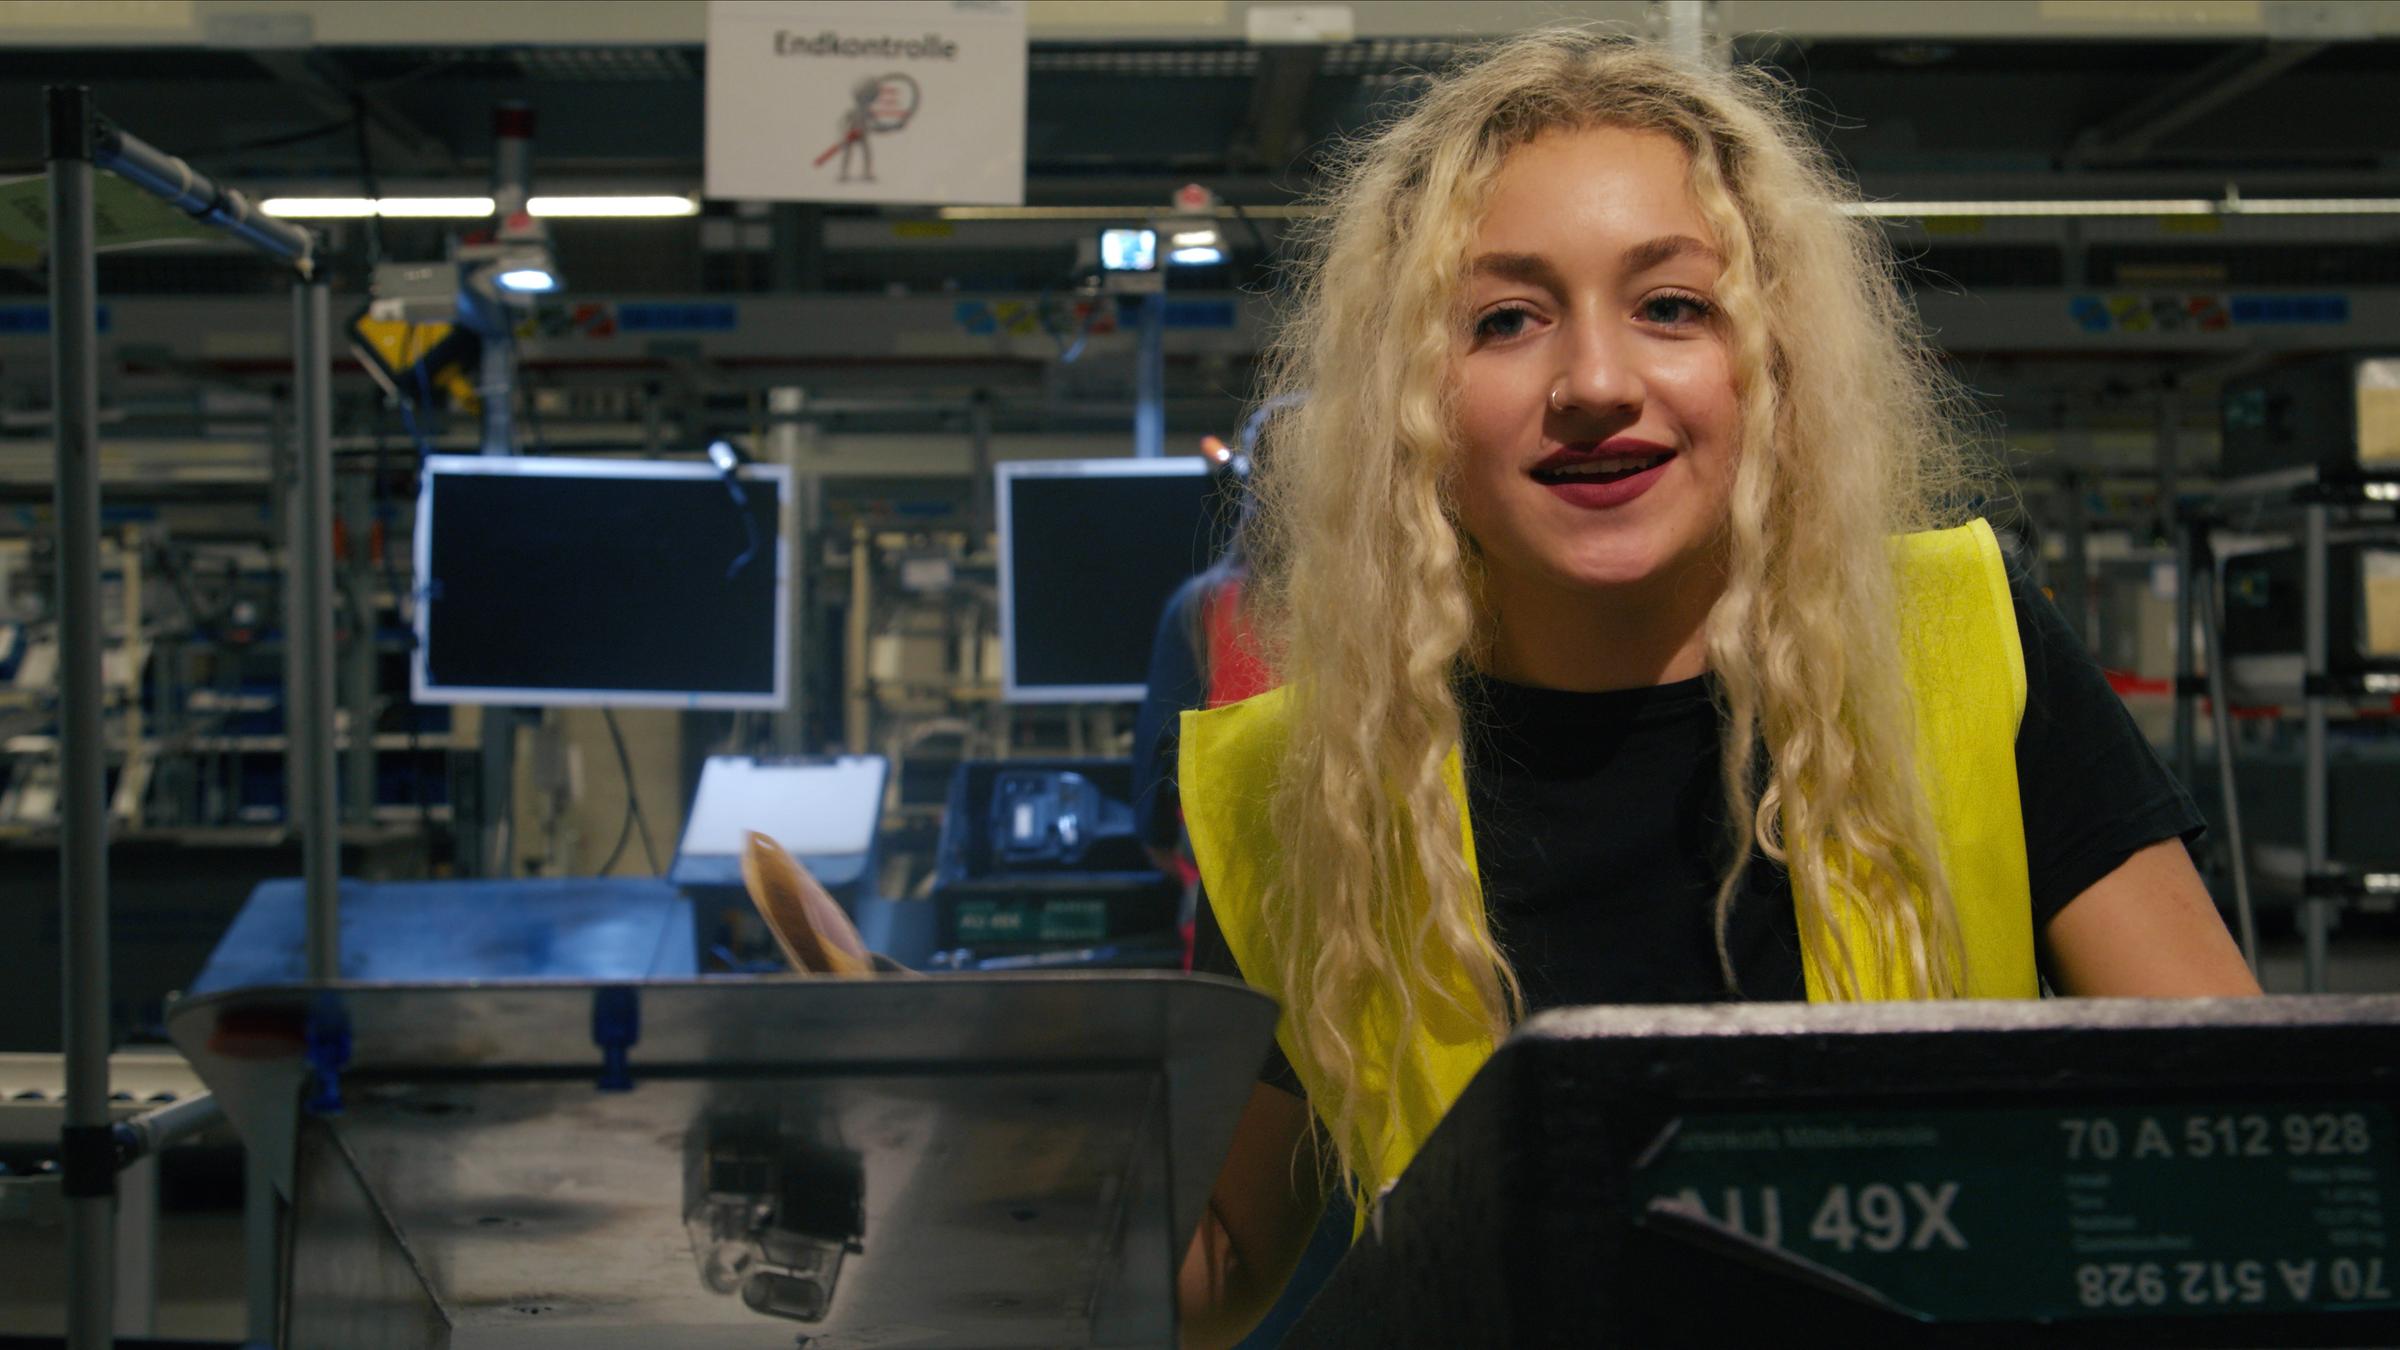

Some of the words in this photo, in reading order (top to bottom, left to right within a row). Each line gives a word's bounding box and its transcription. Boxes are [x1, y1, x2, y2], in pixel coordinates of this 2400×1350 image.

[773, 31, 959, 61] Endkontrolle
[2061, 1117, 2118, 1158] 70
[2133, 1117, 2173, 1158] A
[2186, 1115, 2273, 1157] 512
[2284, 1112, 2370, 1154] 928
[1811, 1182, 1968, 1252] 49X
[2076, 1262, 2166, 1307] 928
[2176, 1260, 2266, 1305] 512
[2276, 1258, 2316, 1303] A
[2330, 1256, 2391, 1300] 70
